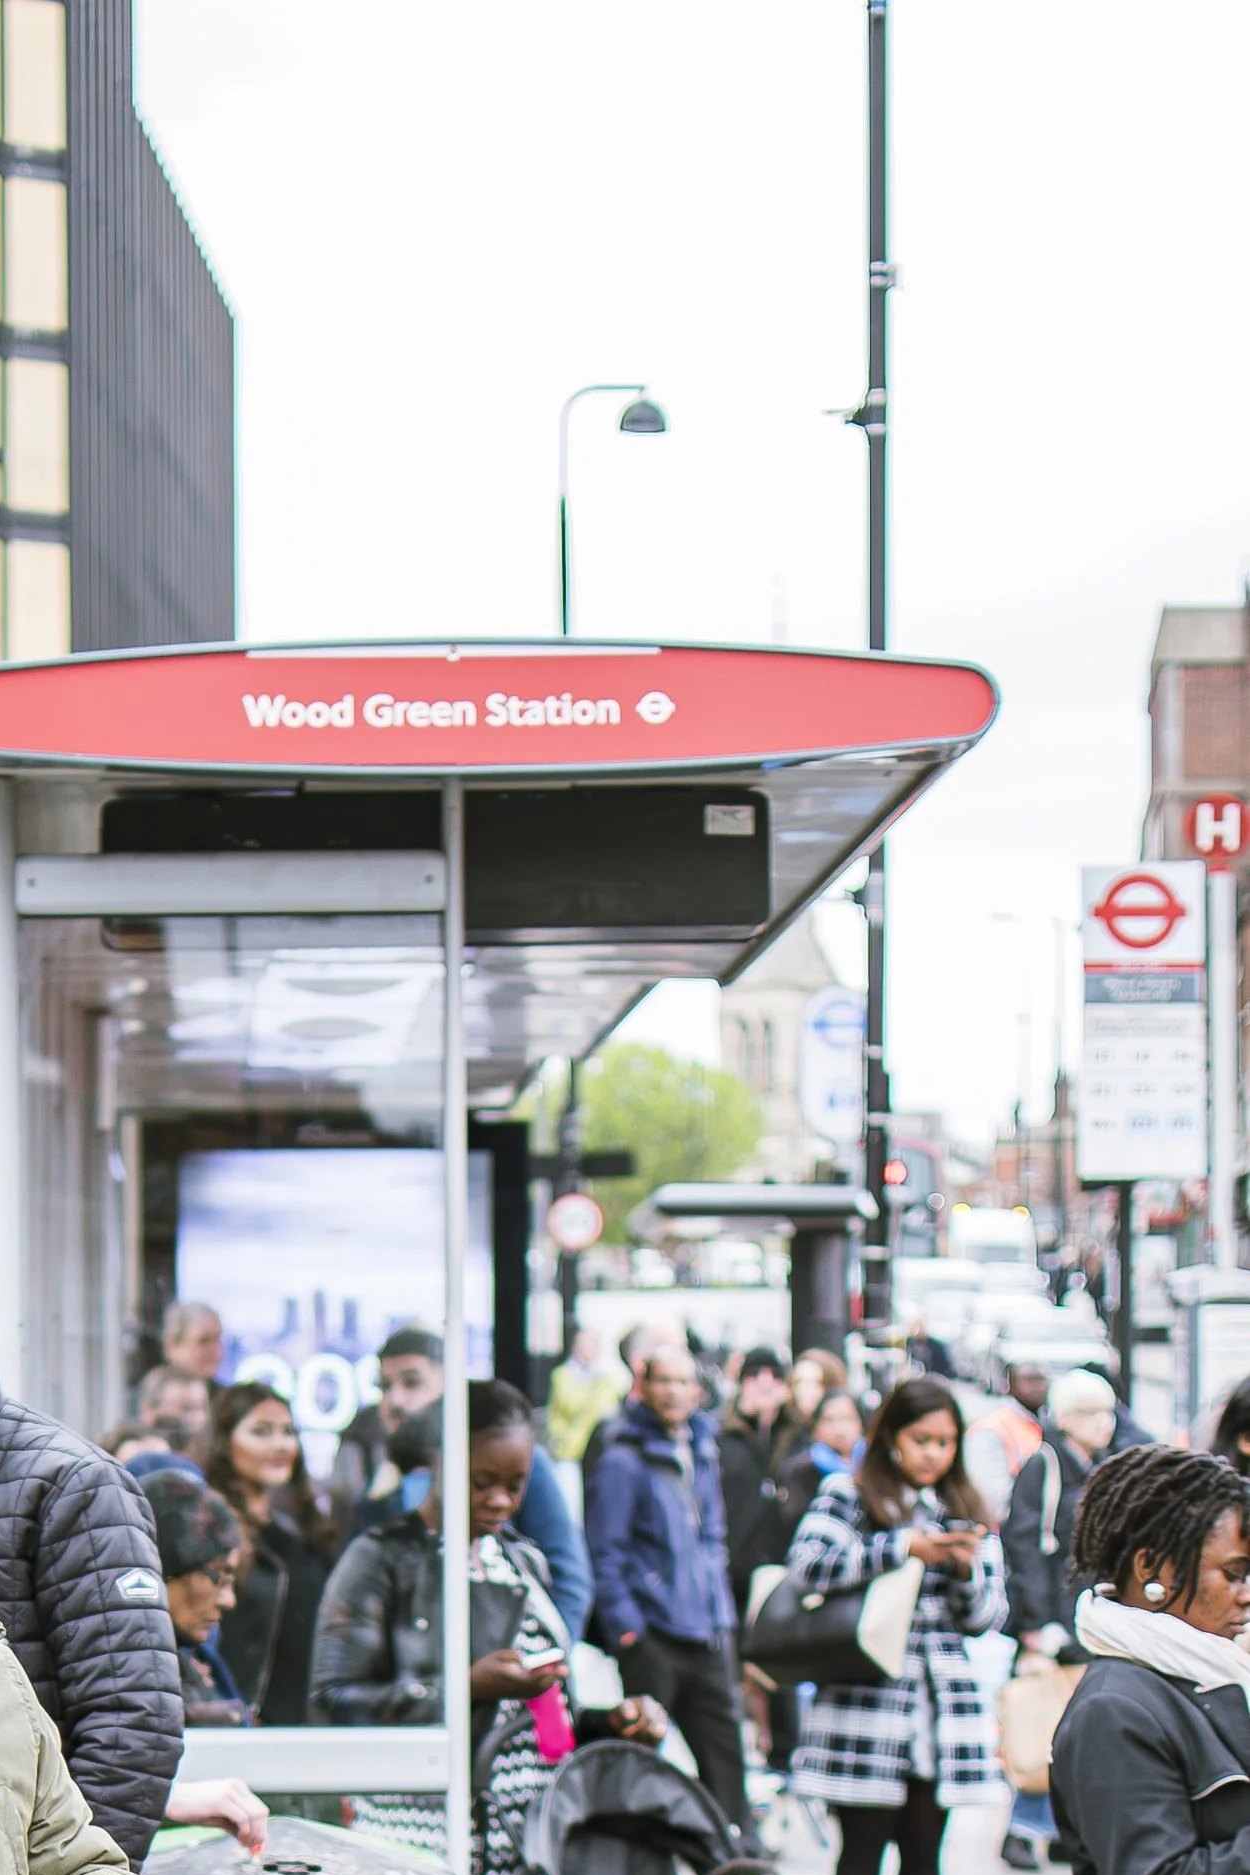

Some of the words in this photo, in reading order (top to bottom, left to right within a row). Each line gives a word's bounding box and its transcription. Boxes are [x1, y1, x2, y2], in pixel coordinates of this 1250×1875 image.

[242, 693, 355, 728] Wood
[363, 693, 477, 728] Green
[485, 691, 621, 728] Station
[1196, 803, 1241, 852] H
